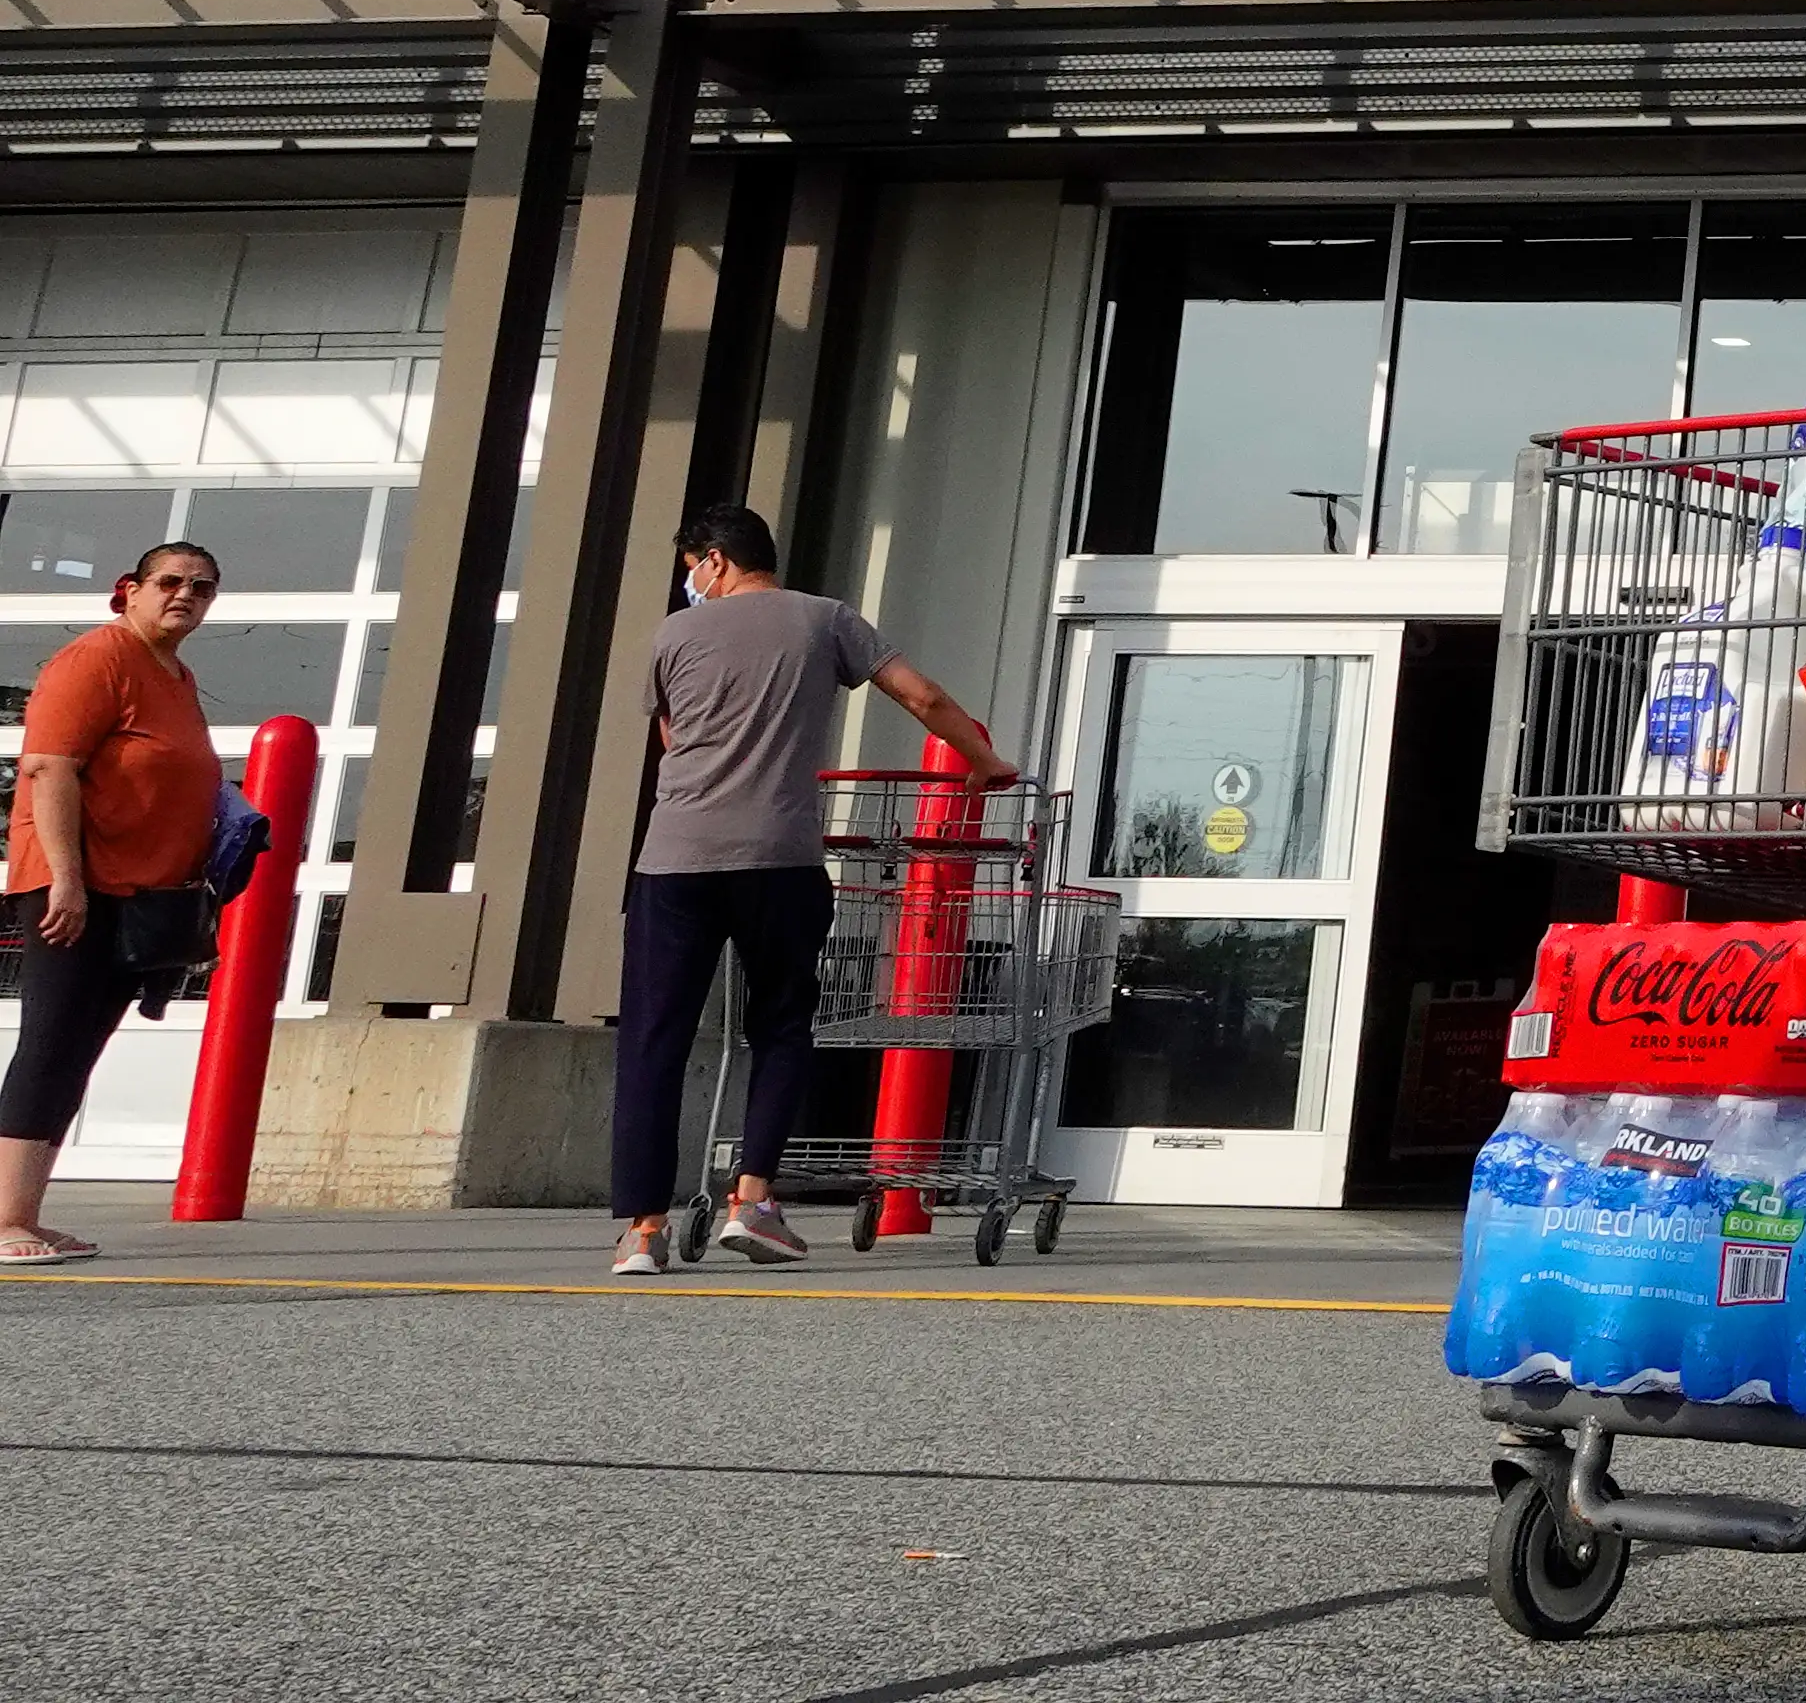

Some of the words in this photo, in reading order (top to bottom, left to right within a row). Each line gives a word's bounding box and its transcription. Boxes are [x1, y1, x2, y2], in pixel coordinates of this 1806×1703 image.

[1206, 825, 1246, 835] CAUTION
[1587, 938, 1802, 1028] Coca-Cola
[1630, 1035, 1671, 1049] ZERO
[1677, 1035, 1729, 1049] SUGAR
[1615, 1127, 1709, 1162] RKLAND
[1737, 1189, 1781, 1216] 40
[1646, 1207, 1713, 1244] water
[1728, 1215, 1801, 1238] BOTTLES
[1614, 1242, 1658, 1260] added
